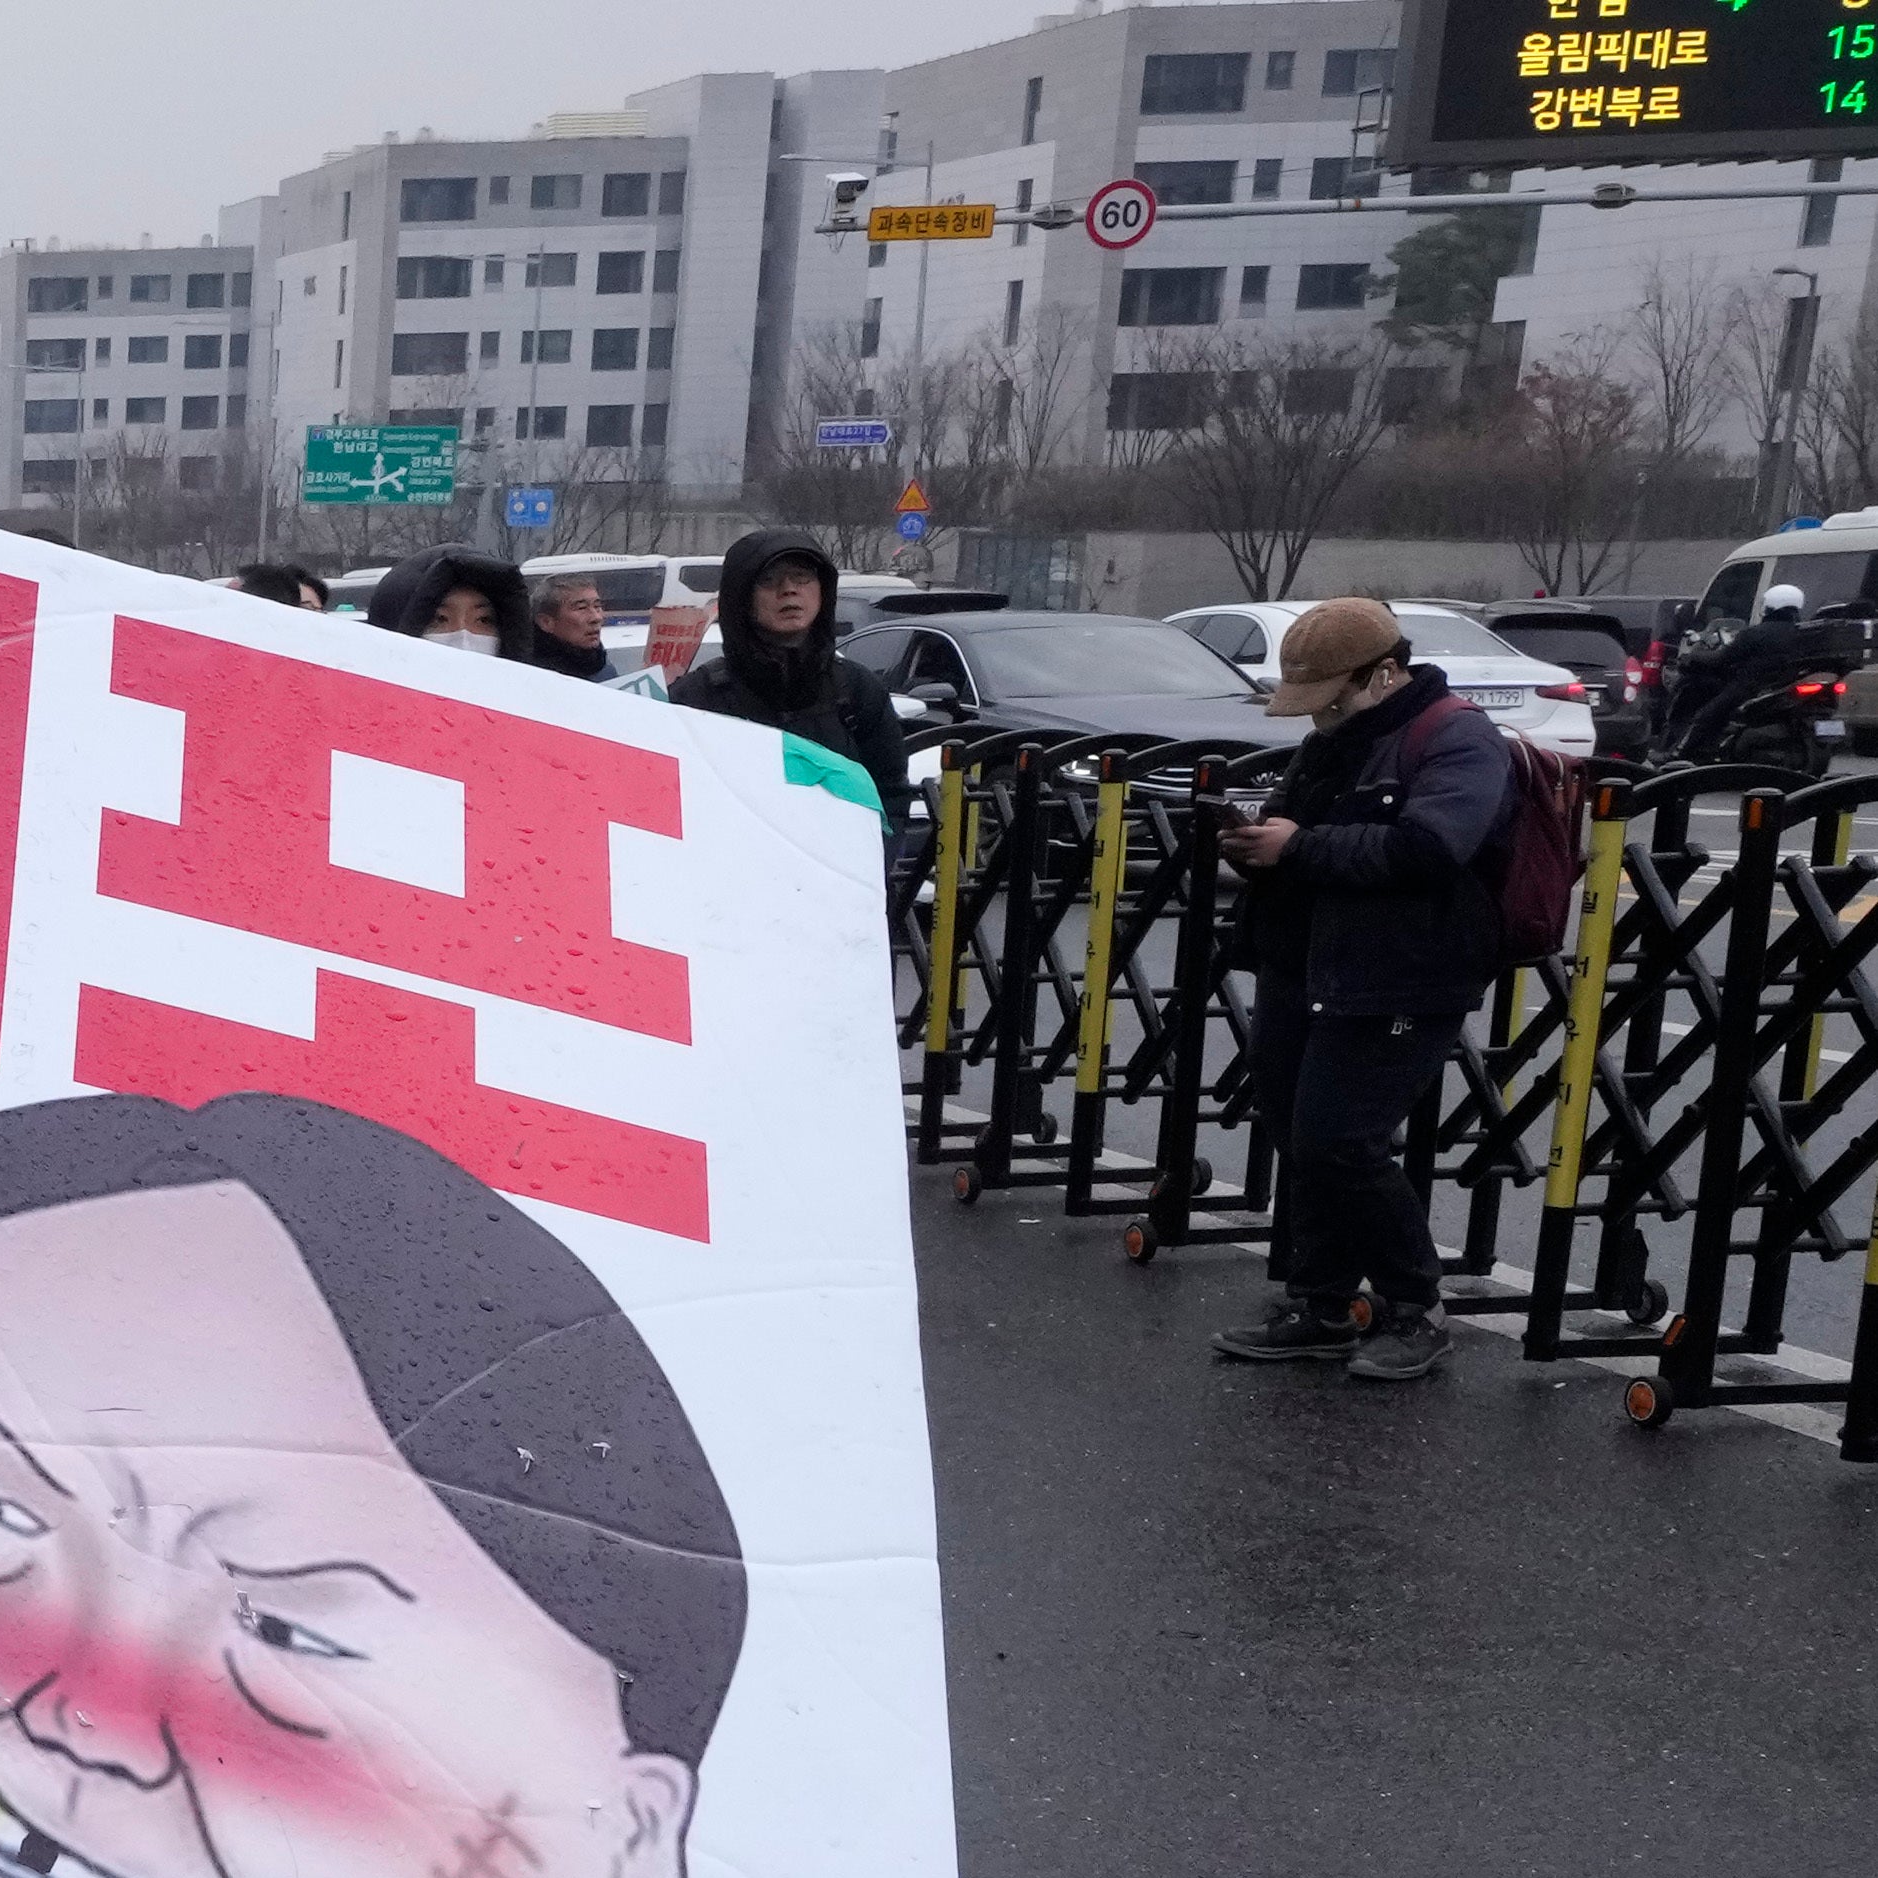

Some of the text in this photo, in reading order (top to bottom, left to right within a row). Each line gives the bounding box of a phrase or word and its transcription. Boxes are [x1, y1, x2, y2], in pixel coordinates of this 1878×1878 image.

[1516, 23, 1876, 77] 올림픽대로 15
[1528, 79, 1867, 131] 강변북로 14
[876, 208, 987, 235] 과속단속장비
[1100, 199, 1142, 230] 60
